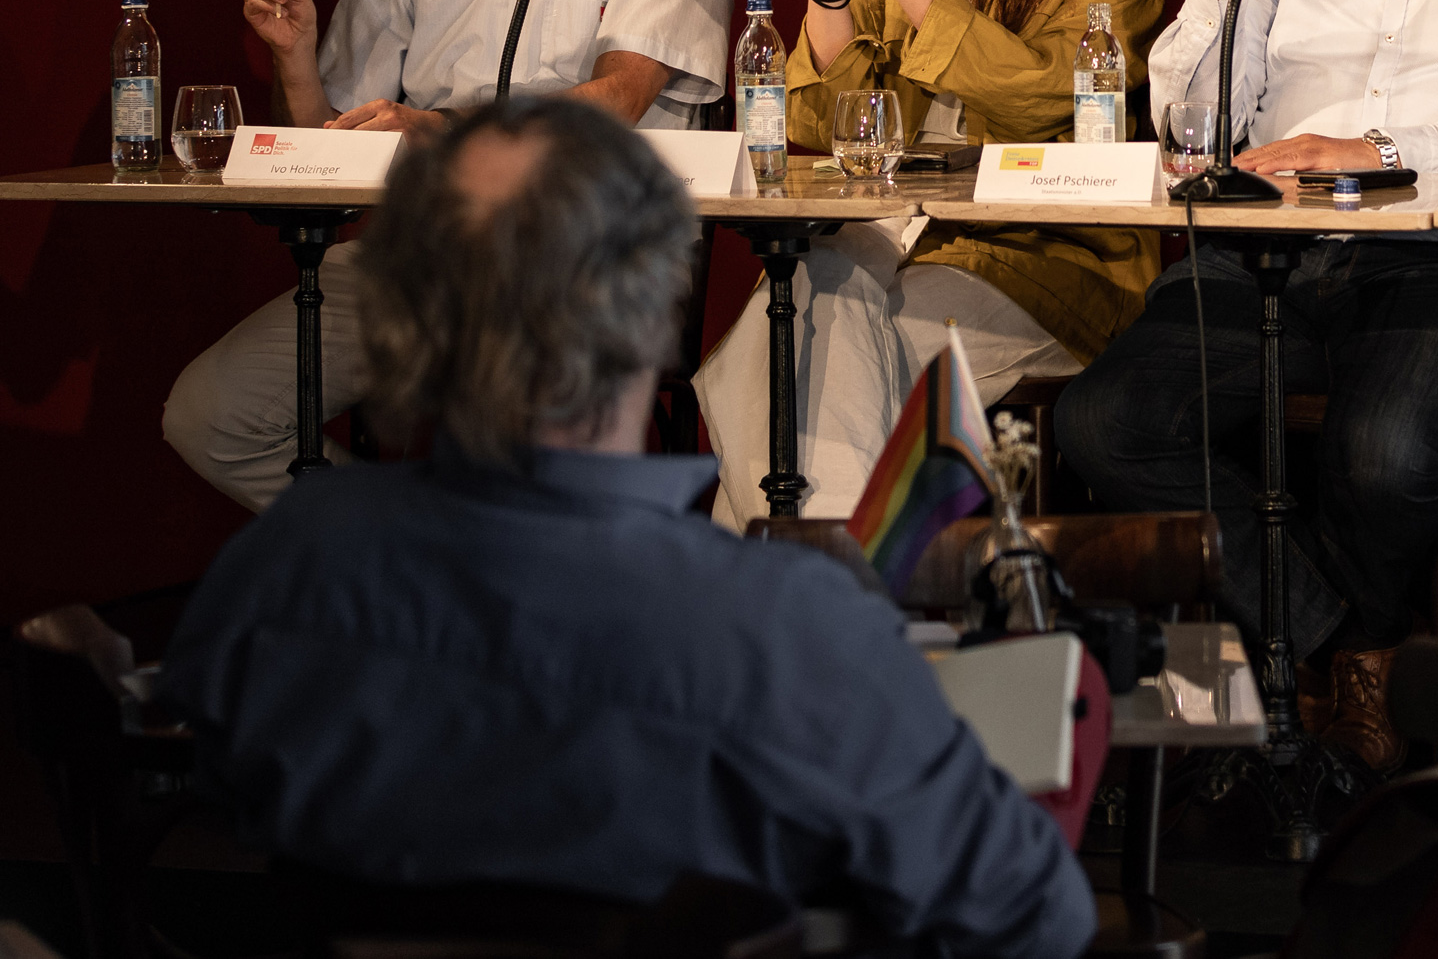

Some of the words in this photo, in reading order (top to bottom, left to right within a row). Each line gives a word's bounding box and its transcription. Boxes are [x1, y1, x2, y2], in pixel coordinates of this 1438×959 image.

[251, 145, 272, 154] SPD
[270, 164, 287, 174] Ivo
[289, 164, 340, 176] Holzinger
[1030, 174, 1061, 186] Josef
[1063, 175, 1118, 187] Pschierer
